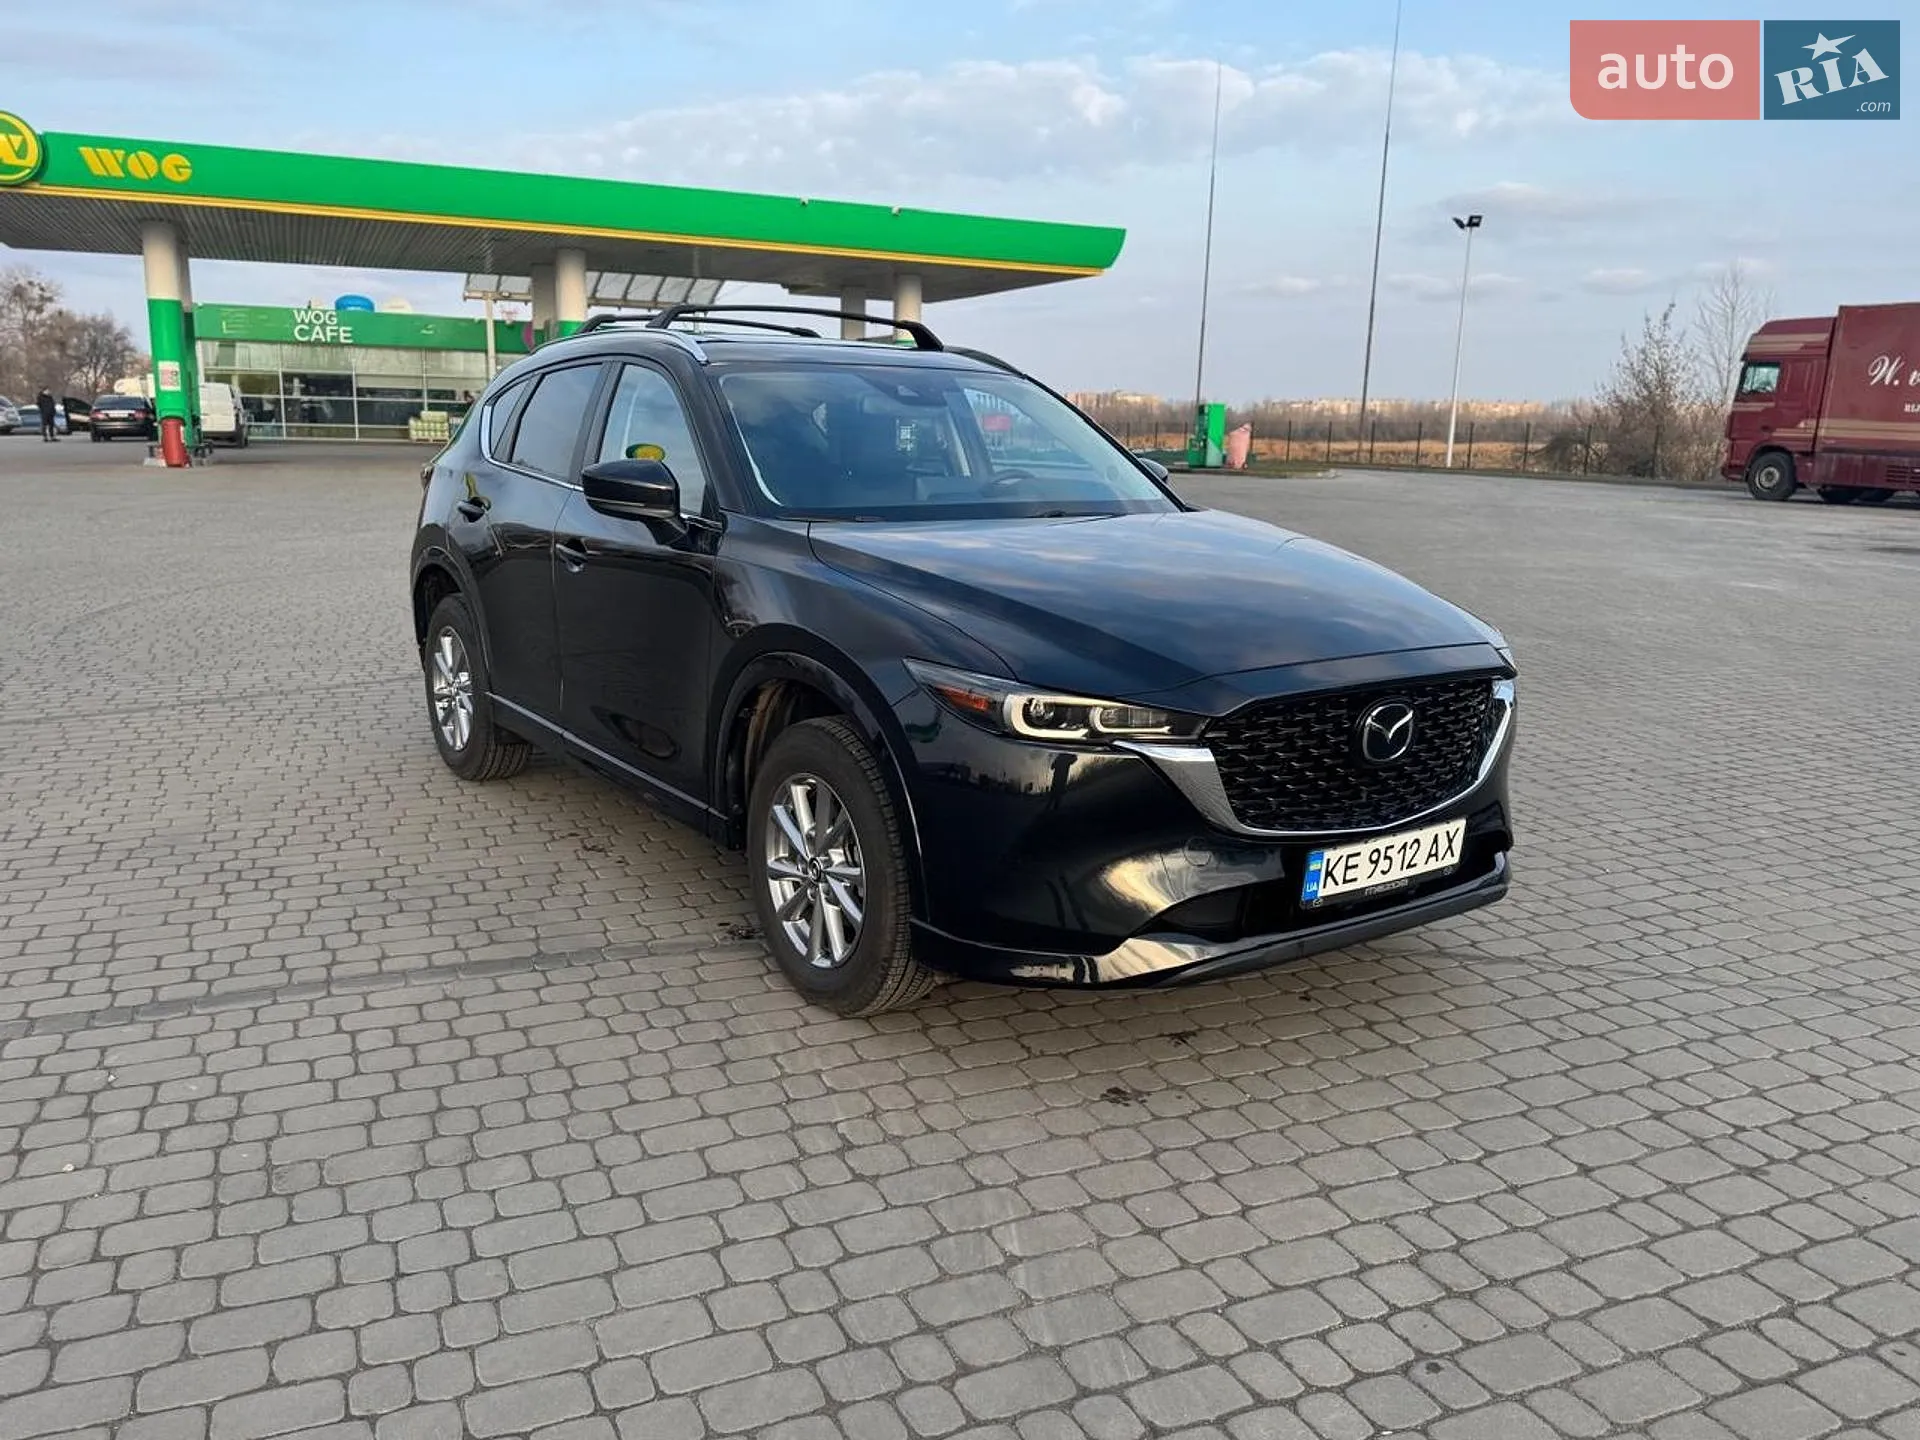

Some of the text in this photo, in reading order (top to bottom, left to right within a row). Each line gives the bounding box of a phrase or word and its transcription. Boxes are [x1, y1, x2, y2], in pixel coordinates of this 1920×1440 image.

[78, 146, 193, 183] WOG
[293, 309, 337, 325] WOG
[294, 324, 354, 343] CAFE
[1322, 827, 1460, 889] KE 9512 AX
[1306, 881, 1318, 892] UA
